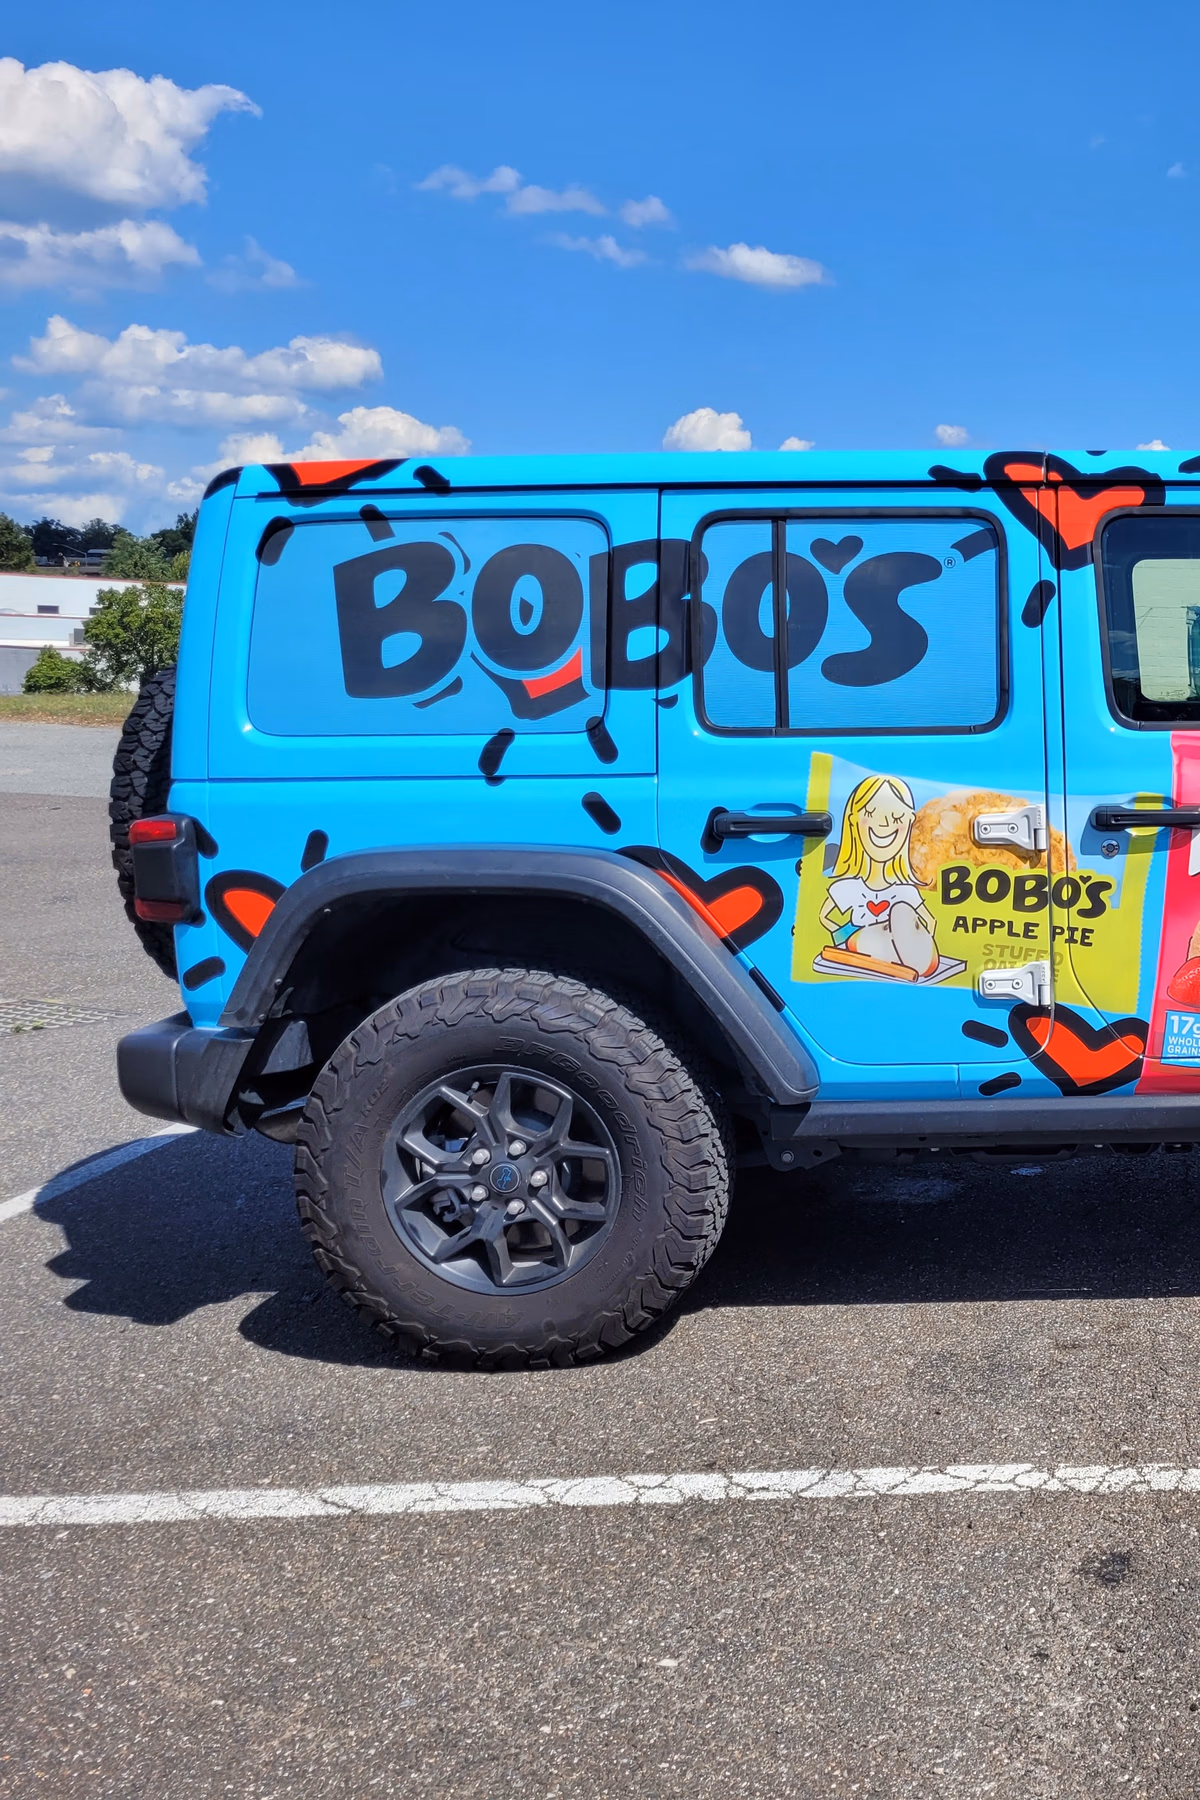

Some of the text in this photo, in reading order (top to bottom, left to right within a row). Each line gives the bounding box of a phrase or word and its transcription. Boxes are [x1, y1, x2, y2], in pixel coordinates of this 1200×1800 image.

[333, 535, 943, 699] BOBO'S
[941, 865, 1112, 918] BOBO'S
[952, 916, 1094, 947] APPLE PIE
